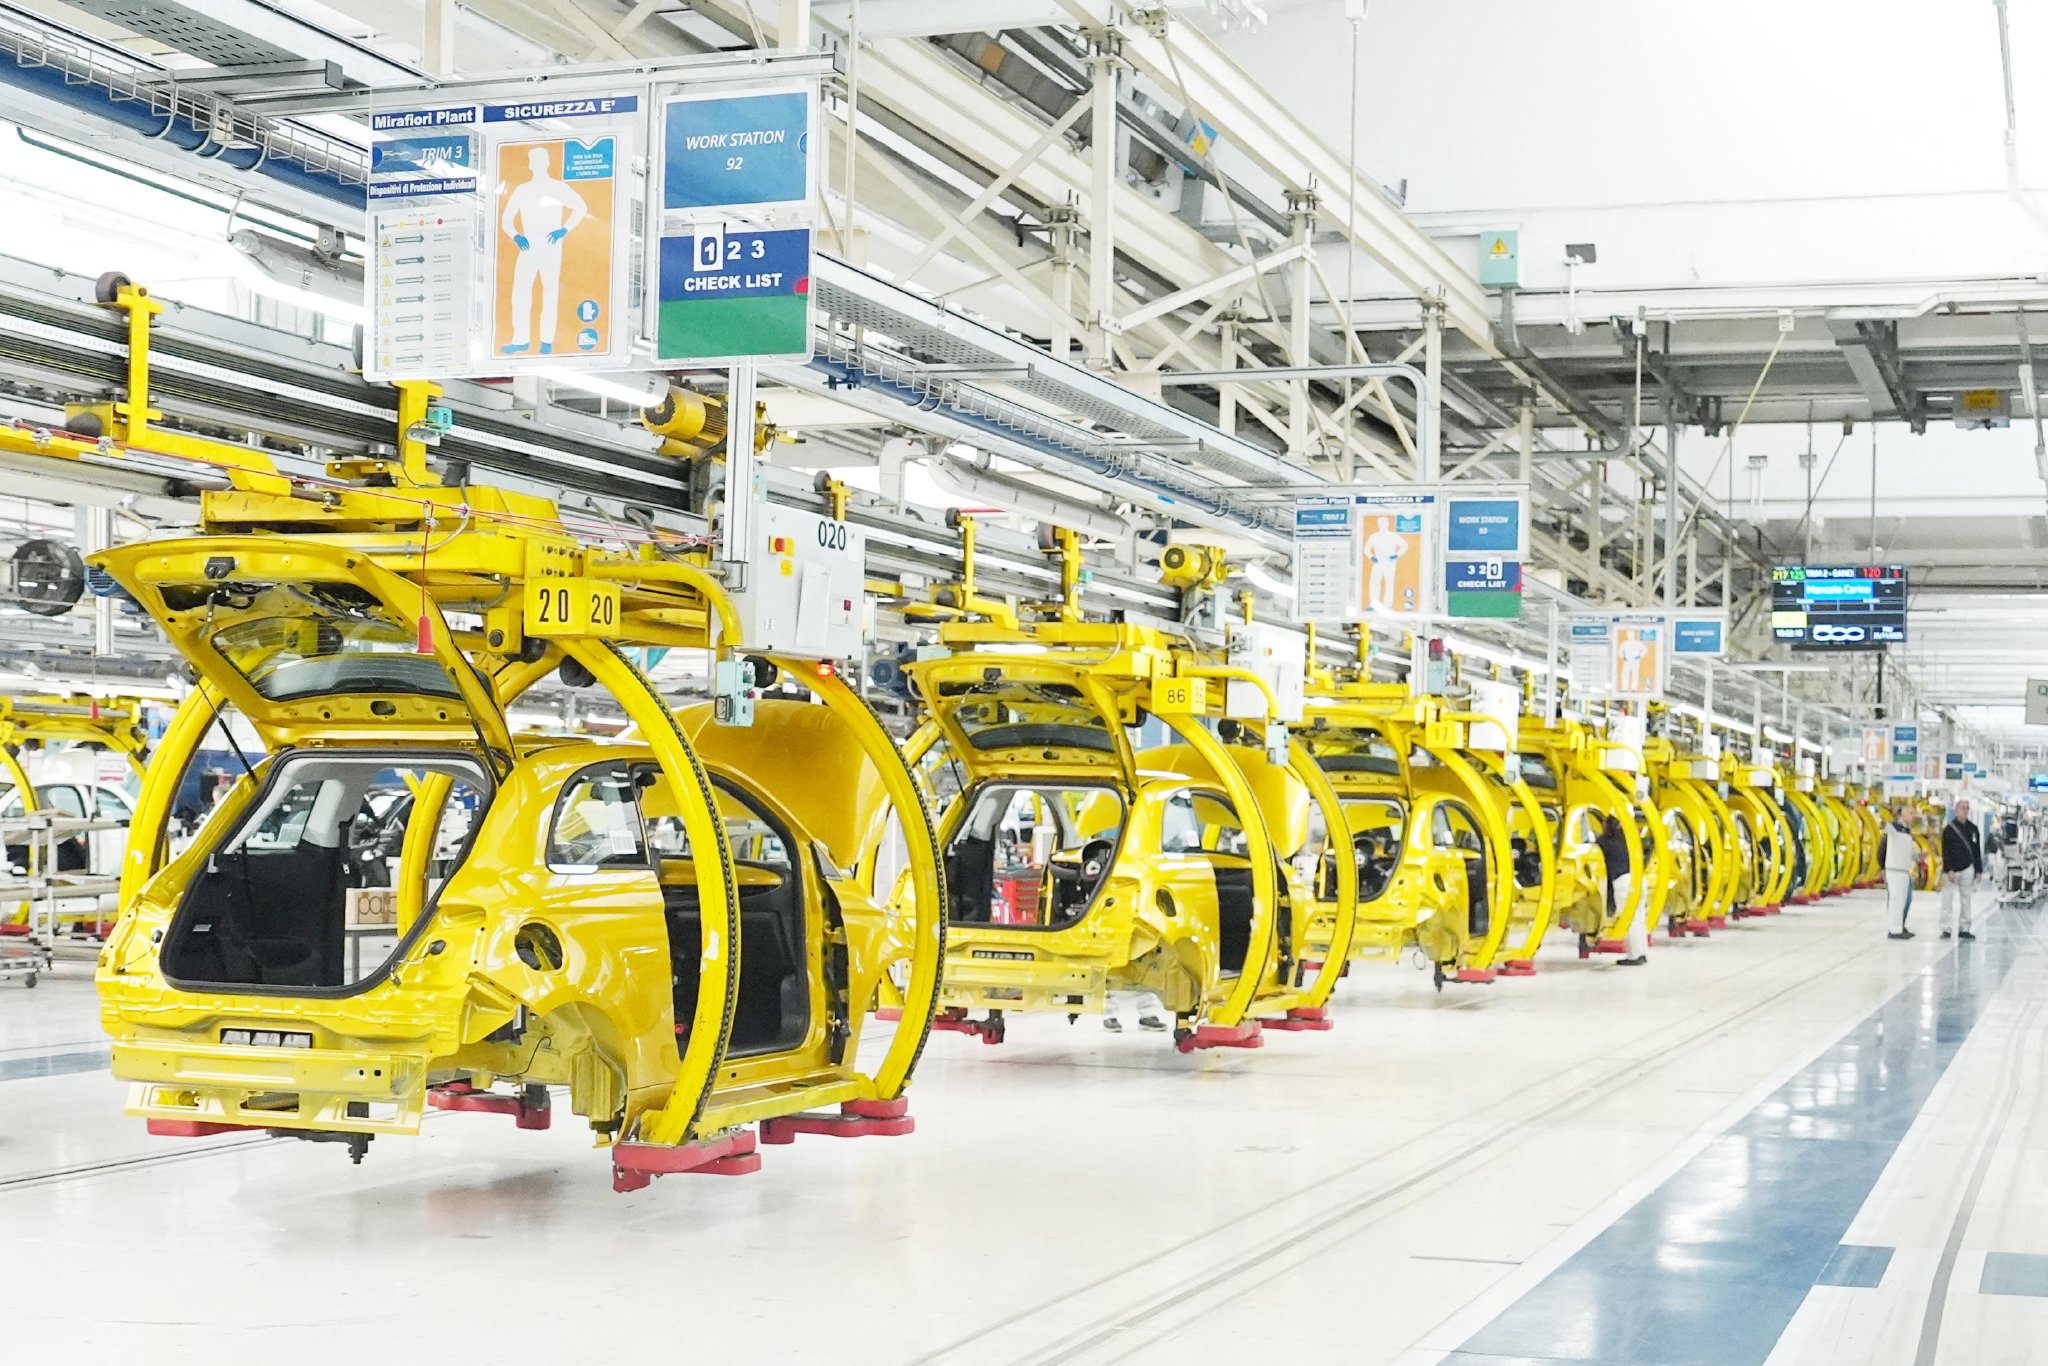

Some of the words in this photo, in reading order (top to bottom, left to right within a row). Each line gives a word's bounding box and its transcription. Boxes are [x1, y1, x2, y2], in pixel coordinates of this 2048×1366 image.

[375, 112, 432, 128] Mirafiori
[436, 109, 473, 123] Plant
[505, 102, 596, 119] SICUREZZA
[600, 100, 616, 112] E'
[686, 133, 727, 150] WORK
[729, 130, 785, 147] STATION
[421, 146, 451, 161] TRIM
[455, 145, 463, 158] 3
[725, 157, 743, 171] 92
[370, 184, 401, 197] Dispositivi
[403, 183, 409, 193] di
[410, 181, 442, 193] Protezione
[443, 179, 476, 190] Individuali
[704, 242, 715, 261] 1
[727, 241, 741, 260] 2
[751, 239, 765, 259] 3
[684, 275, 741, 291] CHECK
[745, 272, 783, 288] LIST
[818, 521, 846, 551] 020
[1467, 565, 1475, 575] 3
[1479, 565, 1486, 575] 2
[1863, 567, 1881, 578] 120
[1457, 580, 1487, 588] CHECK
[1487, 580, 1507, 588] LIST
[539, 588, 568, 622] 20
[591, 593, 613, 625] 20
[1813, 625, 1865, 641] 500
[1168, 689, 1185, 703] 86
